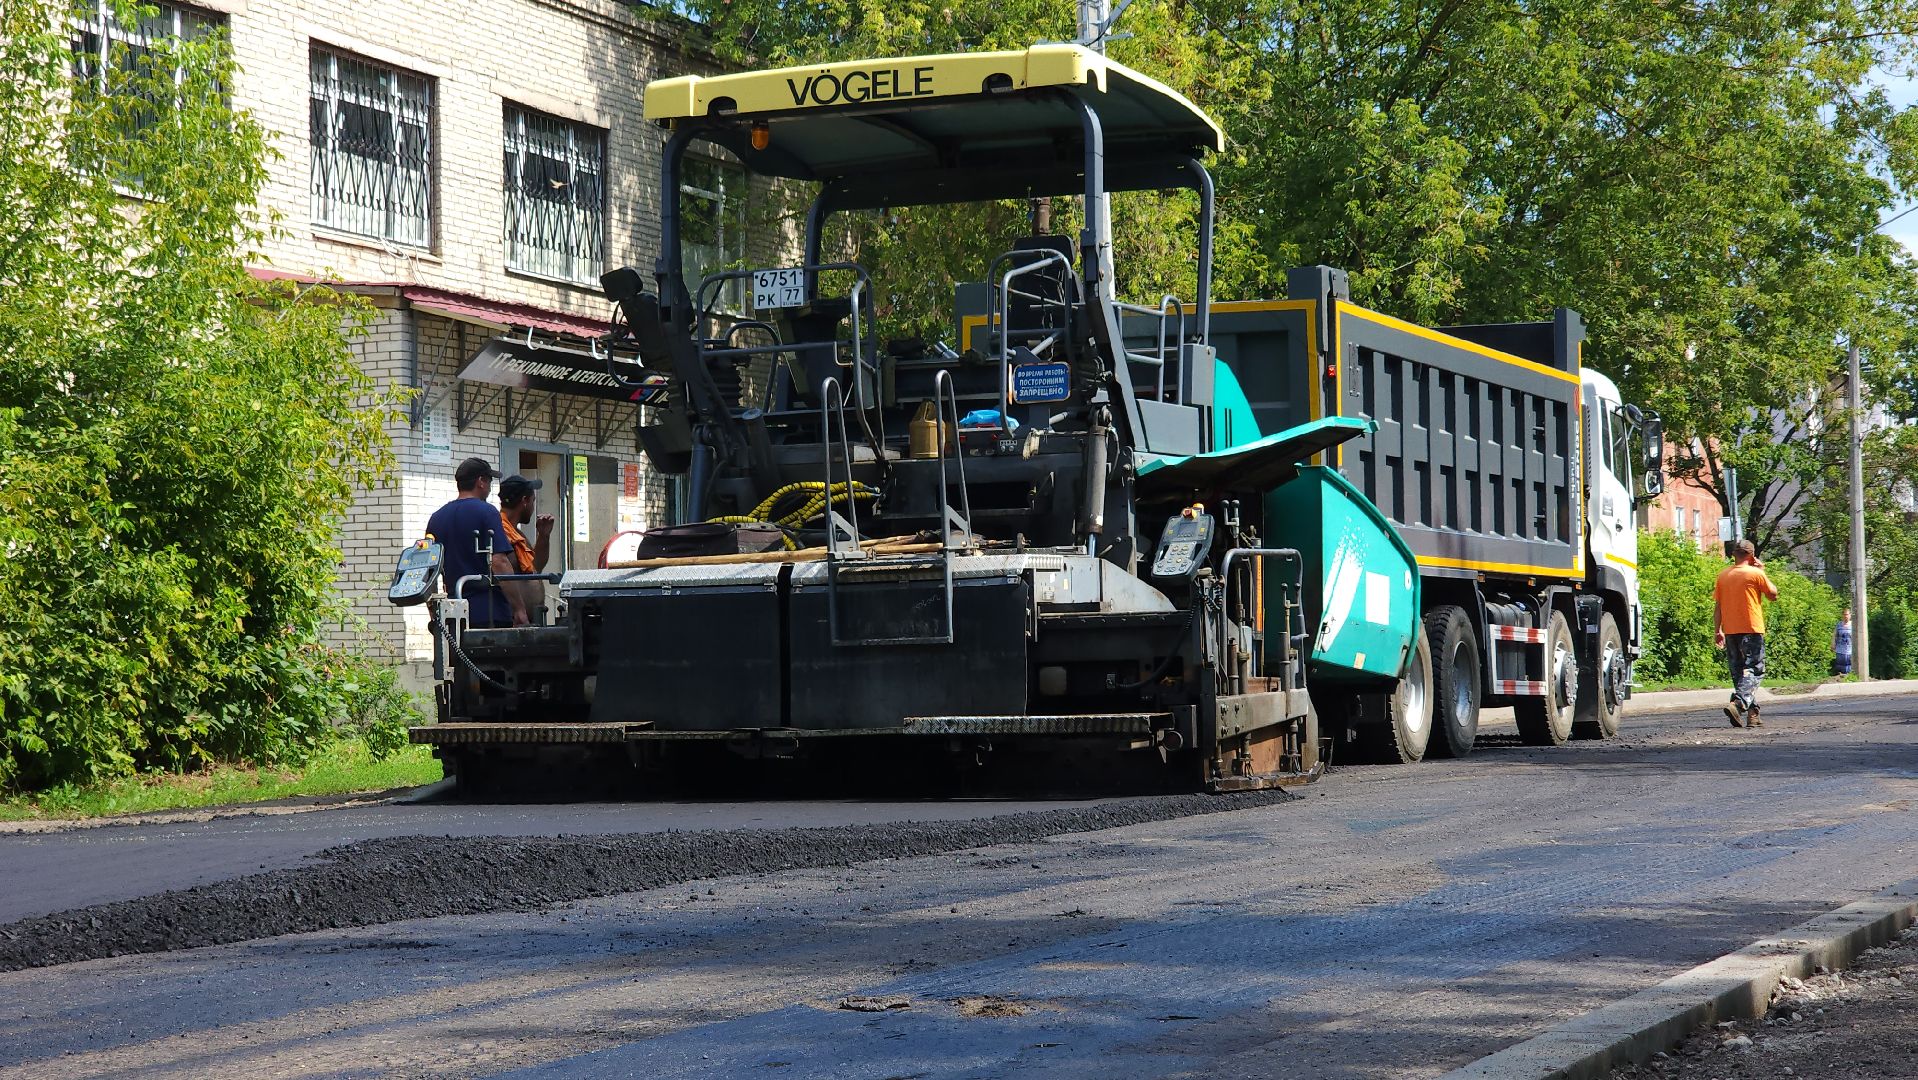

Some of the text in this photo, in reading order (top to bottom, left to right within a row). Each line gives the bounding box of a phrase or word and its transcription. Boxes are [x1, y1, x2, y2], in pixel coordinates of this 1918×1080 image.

[786, 66, 934, 106] VÖGELE
[759, 270, 797, 287] 6751
[785, 288, 800, 300] 77
[1044, 368, 1066, 376] РАБОТЫ
[1019, 377, 1065, 386] ПОСТОРОННИМ
[1019, 387, 1064, 397] ЗАПРЕЩЕНО
